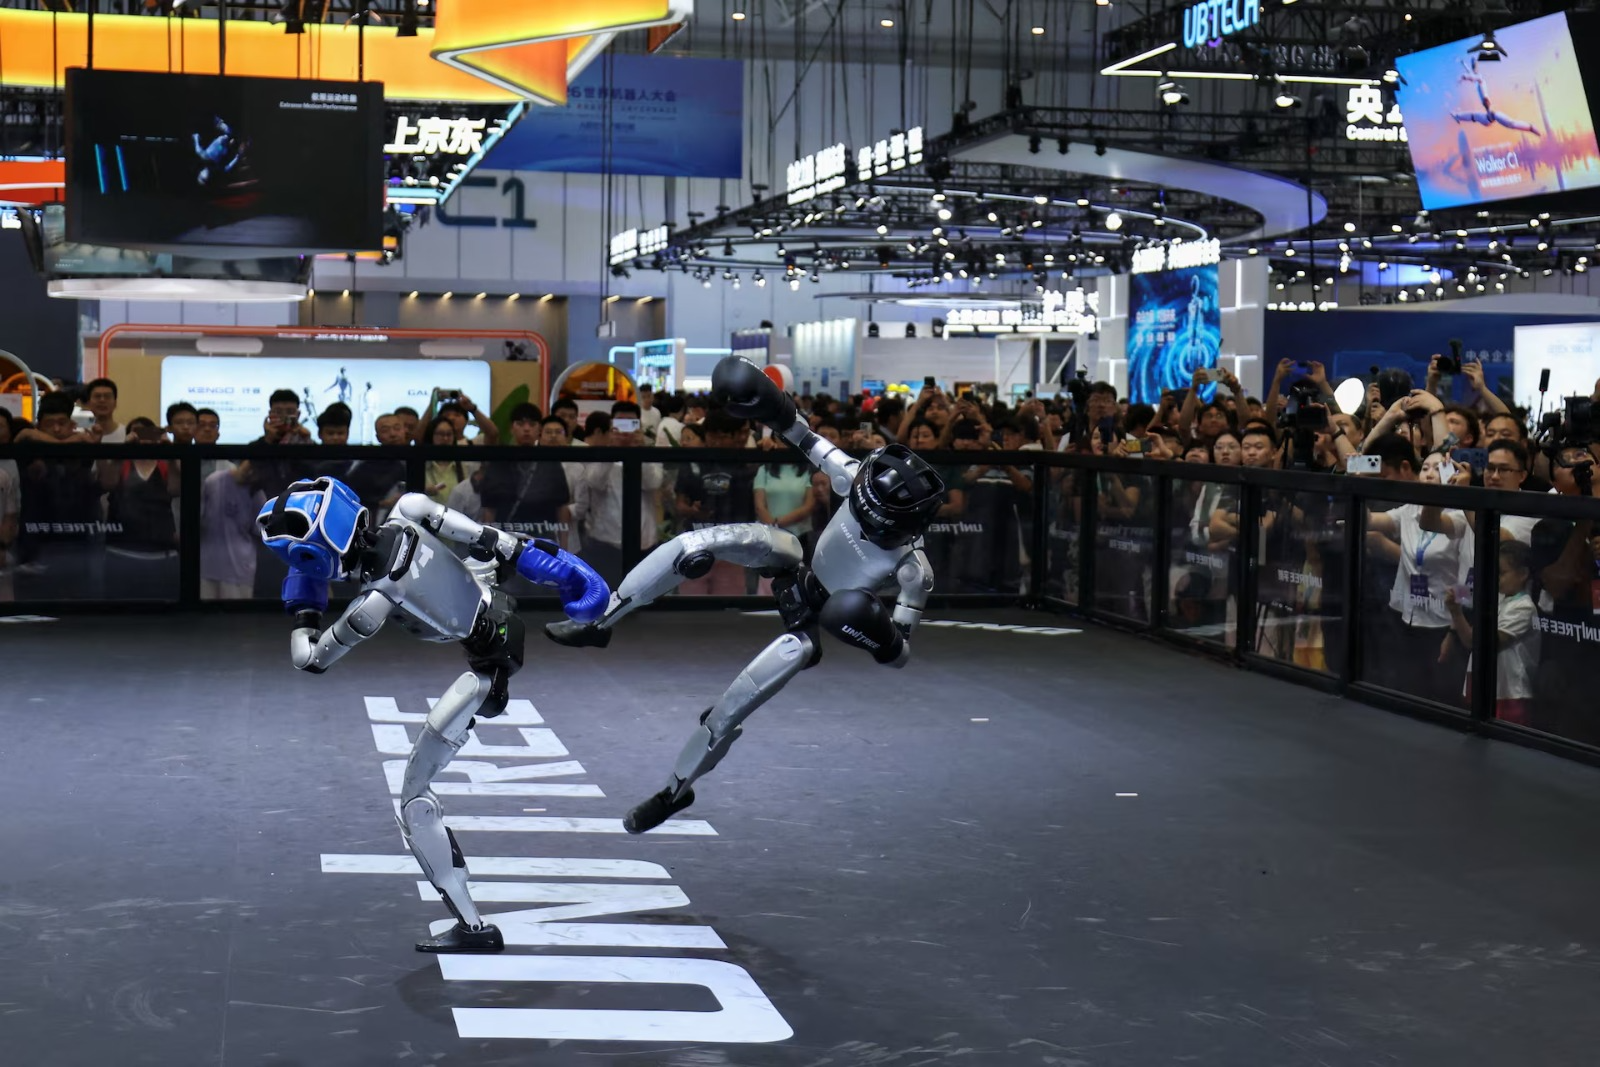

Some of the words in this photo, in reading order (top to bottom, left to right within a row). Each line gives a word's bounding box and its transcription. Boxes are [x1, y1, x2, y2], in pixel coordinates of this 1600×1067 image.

[1184, 0, 1259, 48] UBTECH
[383, 116, 486, 155] 上京东
[1346, 124, 1398, 142] Central
[1475, 153, 1507, 173] Walker
[436, 176, 537, 228] C1
[188, 386, 235, 394] KENGO
[856, 483, 896, 526] UNITREE
[841, 624, 881, 649] UNITREE
[320, 695, 795, 1044] UNITREE
